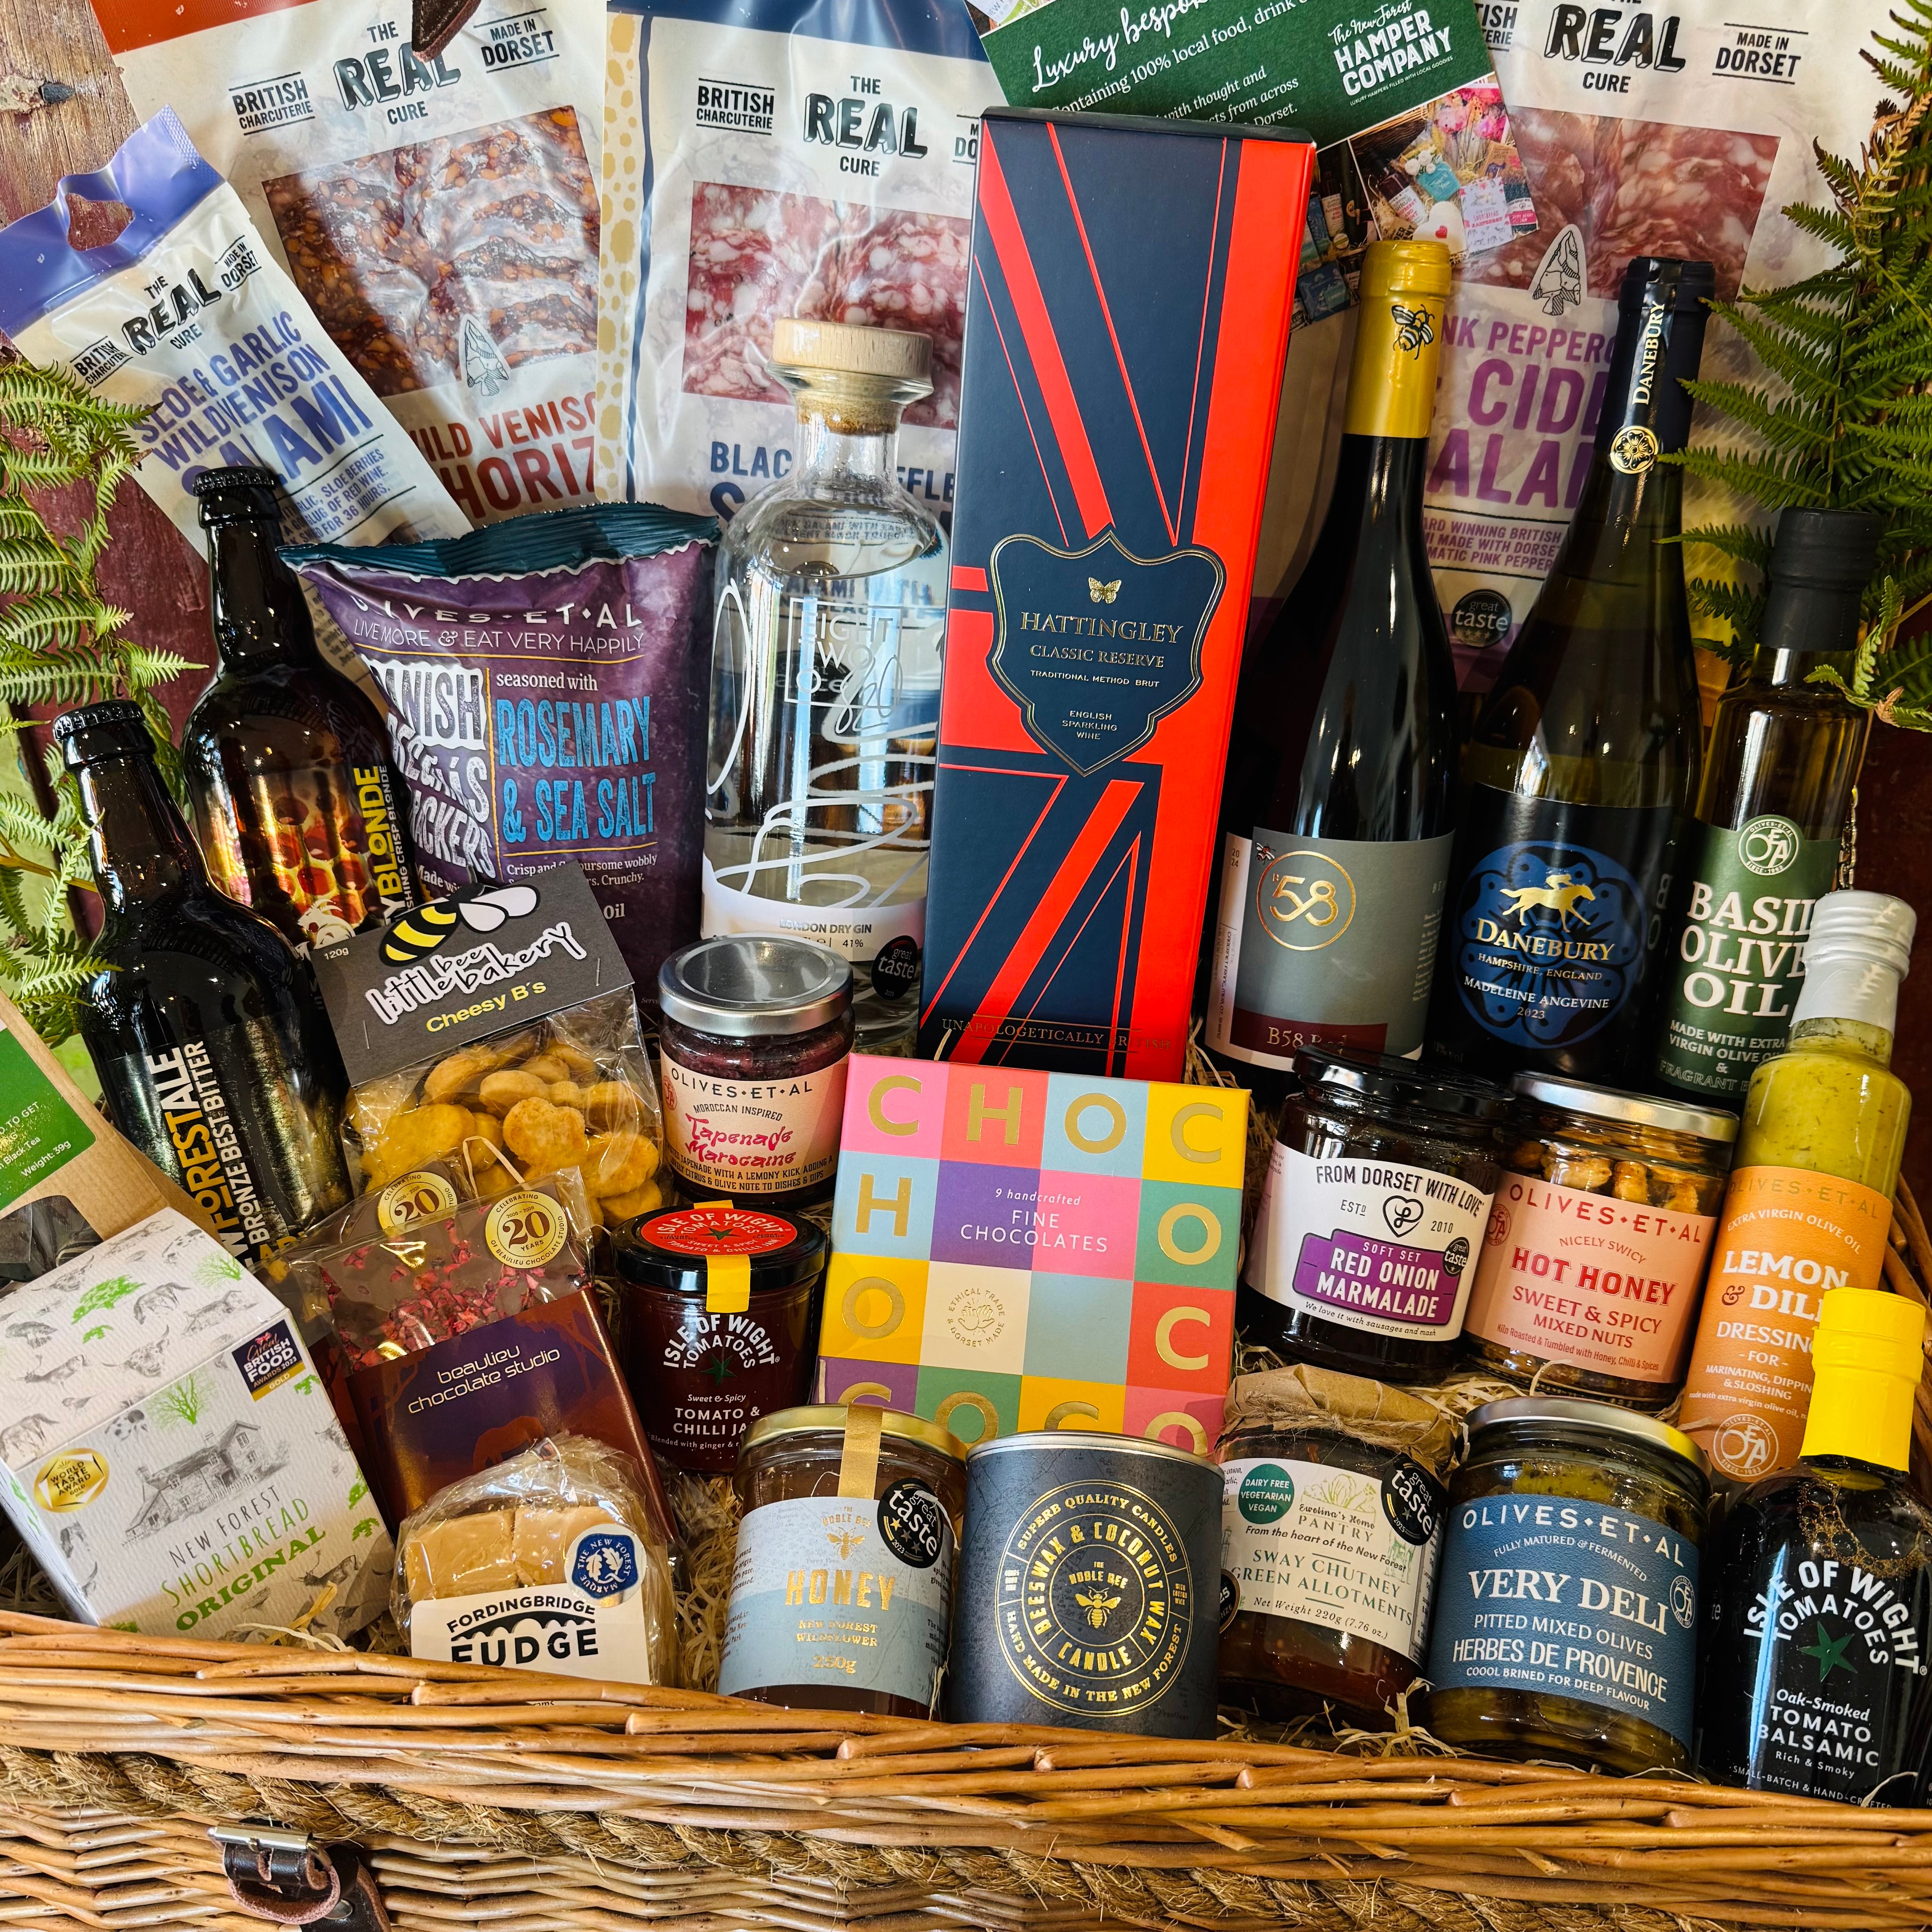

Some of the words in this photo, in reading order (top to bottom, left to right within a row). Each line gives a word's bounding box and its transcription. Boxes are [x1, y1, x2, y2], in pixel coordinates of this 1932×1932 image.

[367, 22, 398, 43] THE
[490, 22, 522, 41] MADE
[525, 19, 537, 33] IN
[1333, 9, 1432, 73] HAMPER
[1544, 4, 1685, 72] REAL
[1736, 32, 1770, 48] MADE
[1775, 37, 1789, 50] IN
[481, 31, 555, 66] DORSET
[1032, 32, 1119, 93] Luxury
[1342, 26, 1452, 95] COMPANY
[1715, 48, 1801, 77] DORSET
[232, 79, 309, 115] BRITISH
[851, 76, 880, 95] THE
[1228, 99, 1259, 122] from
[1260, 77, 1299, 107] across
[1582, 72, 1631, 93] CURE
[239, 101, 313, 129] CHARCUTERIE
[388, 101, 428, 125] CURE
[697, 86, 774, 115] BRITISH
[1254, 103, 1298, 126] Dorset.
[697, 108, 772, 129] CHARCUTERIE
[804, 94, 928, 158] REAL
[840, 156, 880, 177] CURE
[145, 276, 168, 300] THE
[122, 269, 222, 355] REAL
[170, 324, 203, 350] CURE
[1632, 301, 1665, 405] DANEBURY
[141, 375, 206, 443] SLOE
[193, 369, 216, 396] &
[209, 311, 301, 387] GARLIC
[321, 472, 345, 498] SLOE
[346, 449, 385, 481] BERRIES
[354, 619, 380, 640] LIVE
[381, 628, 430, 647] MORE
[439, 631, 458, 647] &
[464, 631, 503, 648] EAT
[504, 633, 565, 650] VERY
[570, 633, 644, 655] HAPPILY
[1020, 612, 1183, 643] HATTINGLEY
[1030, 645, 1094, 662] CLASSIC
[1099, 650, 1164, 667] RESERVE
[497, 671, 564, 690] seasoned
[567, 675, 598, 692] with
[1031, 670, 1089, 681] TRADITIONAL
[1093, 676, 1129, 685] METHOD
[497, 696, 650, 768] ROSEMARY
[1062, 720, 1117, 731] SPARKLING
[1070, 710, 1112, 721] ENGLISH
[503, 779, 526, 843] &
[536, 778, 590, 841] SEA
[597, 772, 656, 839] SALT
[353, 766, 402, 896] BLONDE
[780, 919, 826, 933] LONDON
[830, 925, 852, 934] DRY
[854, 924, 871, 933] GIN
[1475, 918, 1615, 960] DANEBURY
[324, 947, 349, 960] 120g
[439, 950, 485, 971] bee
[457, 925, 582, 990] bakery
[1547, 969, 1602, 980] ENGLAND
[1465, 976, 1536, 1003] MADELEINE
[1539, 995, 1610, 1008] ANGEVINE
[1684, 972, 1788, 1017] OIL
[426, 994, 506, 1032] Cheesy
[1517, 1006, 1545, 1019] 2023
[942, 1019, 1104, 1044] UNAPOLOGETICALLY
[1671, 1020, 1705, 1039] MADE
[1707, 1031, 1745, 1047] WITH
[1749, 1038, 1785, 1048] EXTRA
[183, 1041, 226, 1112] BITTER
[693, 1104, 738, 1114] MOROCCAN
[742, 1106, 783, 1121] INSPIRED
[209, 1116, 242, 1162] BEST
[685, 1113, 793, 1151] Tapenade
[21, 1153, 55, 1177] Weight:
[55, 1140, 71, 1155] 39g
[685, 1169, 706, 1183] CITRUS
[715, 1179, 736, 1189] OLIVE
[775, 1178, 800, 1189] DISHES
[810, 1170, 824, 1182] DIPS
[1317, 1165, 1356, 1184] FROM
[1362, 1168, 1423, 1193] DORSET
[1426, 1178, 1459, 1204] WITH
[226, 1163, 270, 1244] BRONZE
[995, 1188, 1002, 1197] 9
[1007, 1191, 1081, 1205] handcrafted
[1012, 1210, 1060, 1228] FINE
[1431, 1220, 1453, 1234] 2010
[960, 1224, 1108, 1252] CHOCOLATES
[1363, 1242, 1394, 1257] SOFT
[1400, 1250, 1421, 1262] SET
[1560, 1236, 1605, 1247] NICELY
[1608, 1241, 1647, 1264] SWICY
[1330, 1248, 1371, 1278] RED
[1379, 1261, 1439, 1291] ONION
[1509, 1245, 1571, 1283] HOT
[1576, 1264, 1677, 1306] HONEY
[1723, 1251, 1849, 1289] LEMON
[1316, 1271, 1439, 1318] MARMALADE
[1513, 1285, 1582, 1316] SWEET
[1585, 1306, 1600, 1323] &
[1607, 1310, 1662, 1334] SPICY
[1305, 1302, 1317, 1311] We
[1319, 1305, 1335, 1317] love
[1346, 1315, 1364, 1325] with
[1366, 1319, 1402, 1333] sausages
[1533, 1314, 1588, 1338] MIXED
[1592, 1330, 1633, 1348] NUTS
[437, 1346, 520, 1384] beaulieu
[683, 1335, 755, 1369] TOMATOES
[408, 1370, 501, 1414] chocolate
[505, 1348, 561, 1377] studio
[675, 1408, 743, 1420] TOMATO
[751, 1406, 760, 1416] &
[725, 1394, 746, 1403] Spicy
[673, 1423, 725, 1435] CHILLI
[1065, 1494, 1129, 1509] QUALITY
[1241, 1492, 1291, 1502] VEGETARIAN
[1249, 1504, 1277, 1512] VEGAN
[169, 1530, 208, 1568] NEW
[217, 1486, 281, 1537] FOREST
[162, 1499, 309, 1608] SHORTBREAD
[175, 1526, 326, 1631] ORIGINAL
[785, 1568, 895, 1610] HONEY
[1253, 1550, 1305, 1568] SWAY
[1312, 1559, 1400, 1598] CHUTNEY
[1231, 1567, 1291, 1585] GREEN
[1298, 1576, 1412, 1625] ALLOTMENTS
[1468, 1569, 1571, 1603] VERY
[1577, 1578, 1669, 1635] DELI
[446, 1596, 595, 1633] FORDINGBRIDGE
[451, 1628, 598, 1666] FUDGE
[1474, 1614, 1528, 1629] PITTED
[1532, 1618, 1592, 1639] MIXED
[1596, 1629, 1653, 1659] OLIVES
[813, 1655, 856, 1674] 250g
[1058, 1641, 1132, 1671] CANDLE
[1453, 1639, 1524, 1662] HERBES
[1530, 1641, 1560, 1668] DE
[1565, 1647, 1667, 1702] PROVENCE
[1777, 1689, 1870, 1721] Oak-Smoked
[1770, 1705, 1870, 1742] TOMATO
[1759, 1725, 1879, 1766] BALSAMIC
